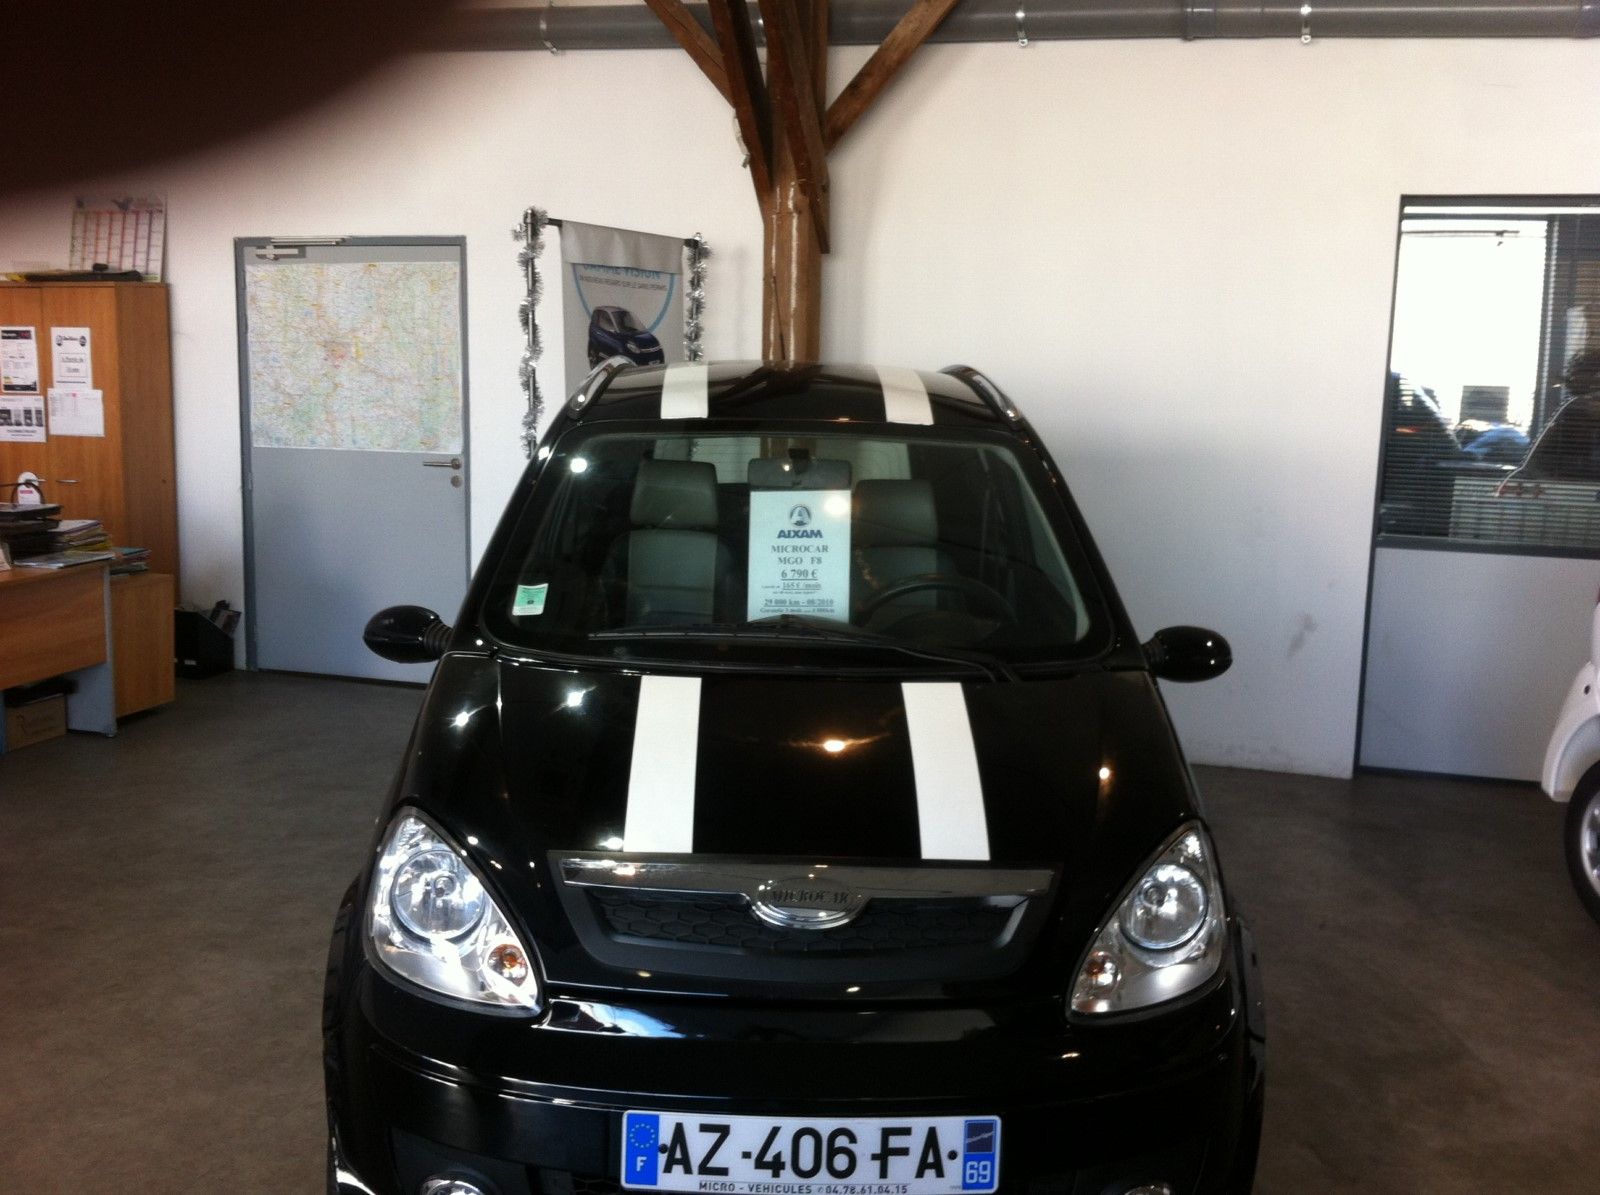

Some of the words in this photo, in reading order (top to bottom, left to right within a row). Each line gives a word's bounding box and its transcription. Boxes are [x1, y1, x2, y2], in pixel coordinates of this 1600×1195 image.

[777, 529, 823, 539] AIXAM
[771, 544, 829, 554] MICROCAR
[778, 556, 803, 566] MGO
[781, 569, 788, 579] 6
[790, 569, 809, 579] 790
[811, 569, 819, 579] €
[636, 1156, 647, 1172] F
[965, 1160, 991, 1184] 69
[699, 1182, 735, 1193] MICRO
[749, 1184, 812, 1195] VEHICULES
